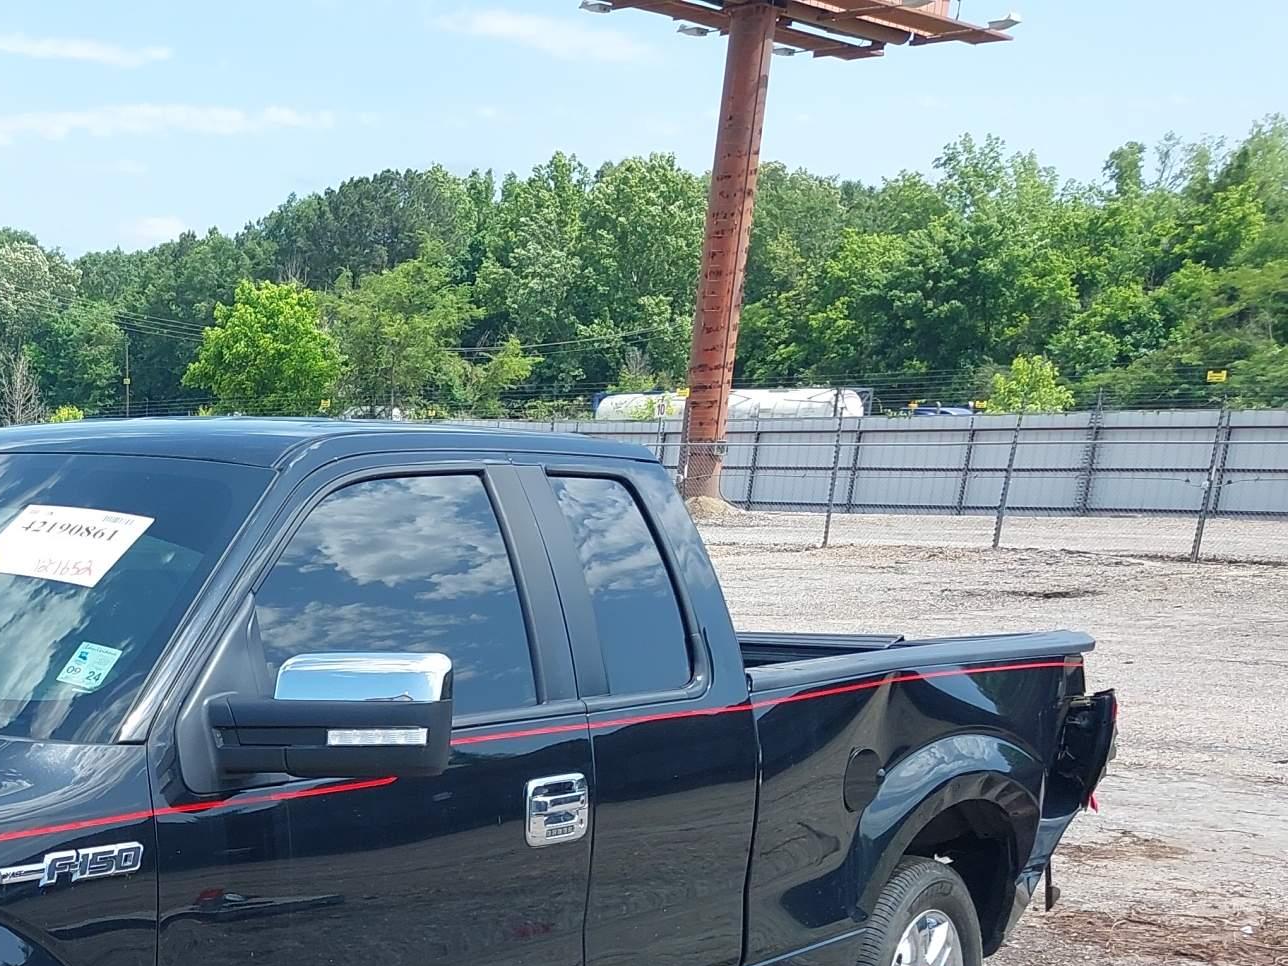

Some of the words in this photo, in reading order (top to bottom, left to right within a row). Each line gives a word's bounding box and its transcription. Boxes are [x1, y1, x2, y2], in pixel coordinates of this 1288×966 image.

[657, 403, 666, 416] 10
[21, 520, 120, 542] 42190861
[66, 665, 82, 674] 09
[86, 670, 103, 682] 24
[39, 841, 144, 887] F-150
